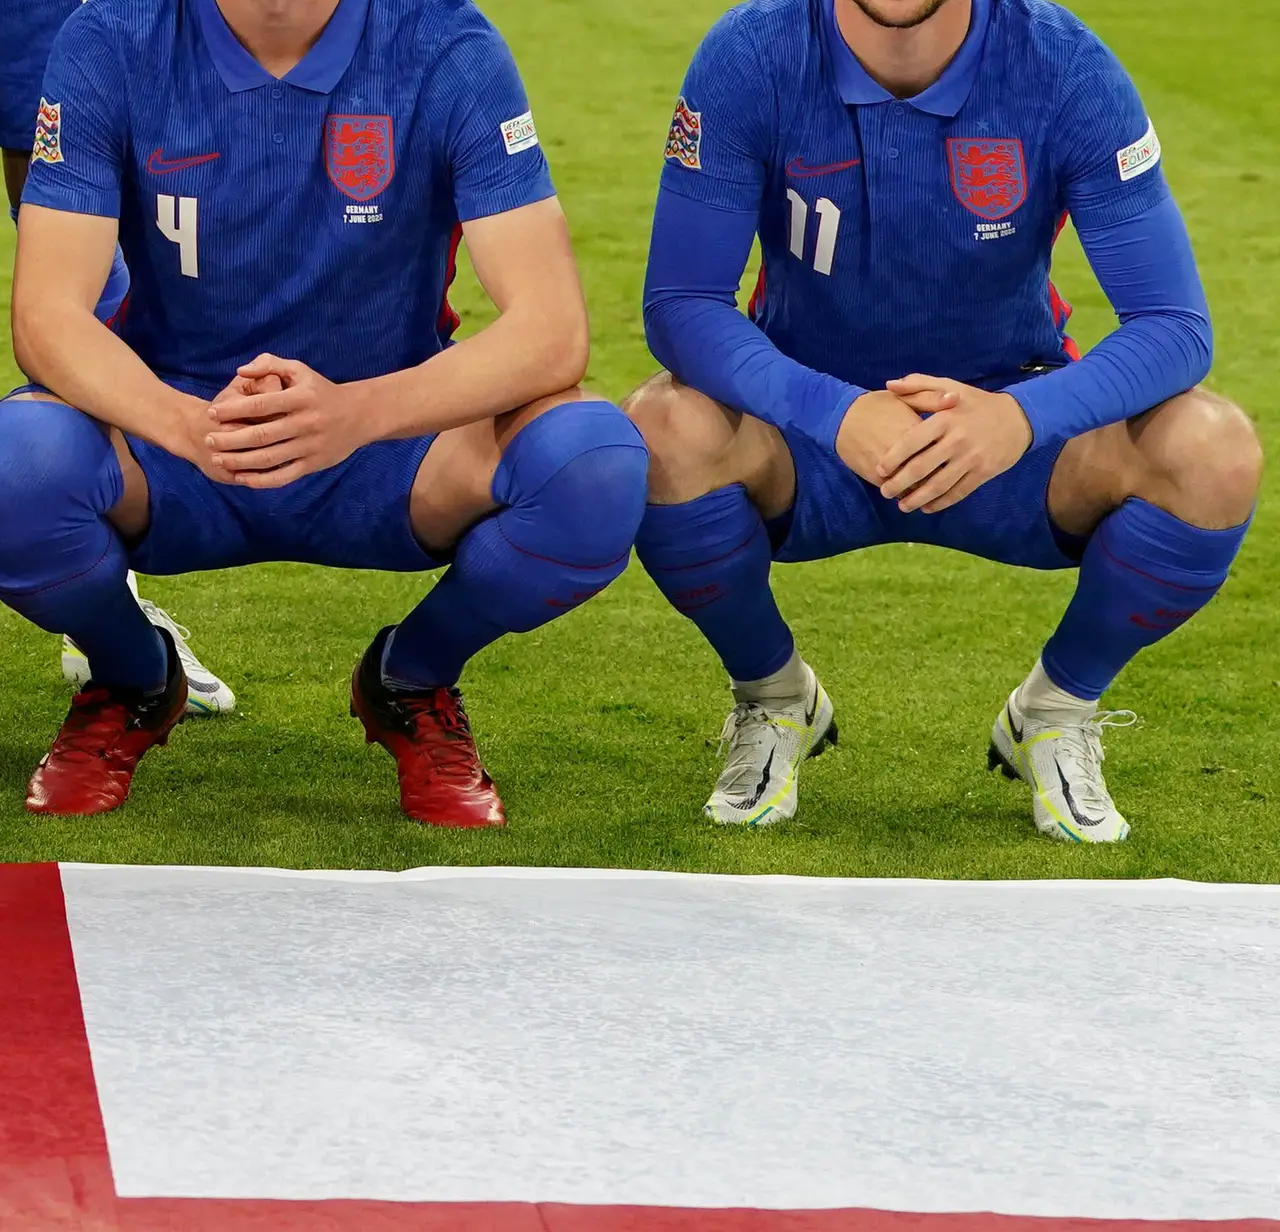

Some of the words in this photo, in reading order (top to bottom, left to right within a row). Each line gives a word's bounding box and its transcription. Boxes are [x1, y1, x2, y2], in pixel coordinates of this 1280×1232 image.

[345, 205, 379, 214] GERMANY
[348, 214, 367, 223] JUNE
[785, 188, 841, 276] 11
[976, 221, 1012, 232] GERMANY
[156, 194, 198, 279] 4
